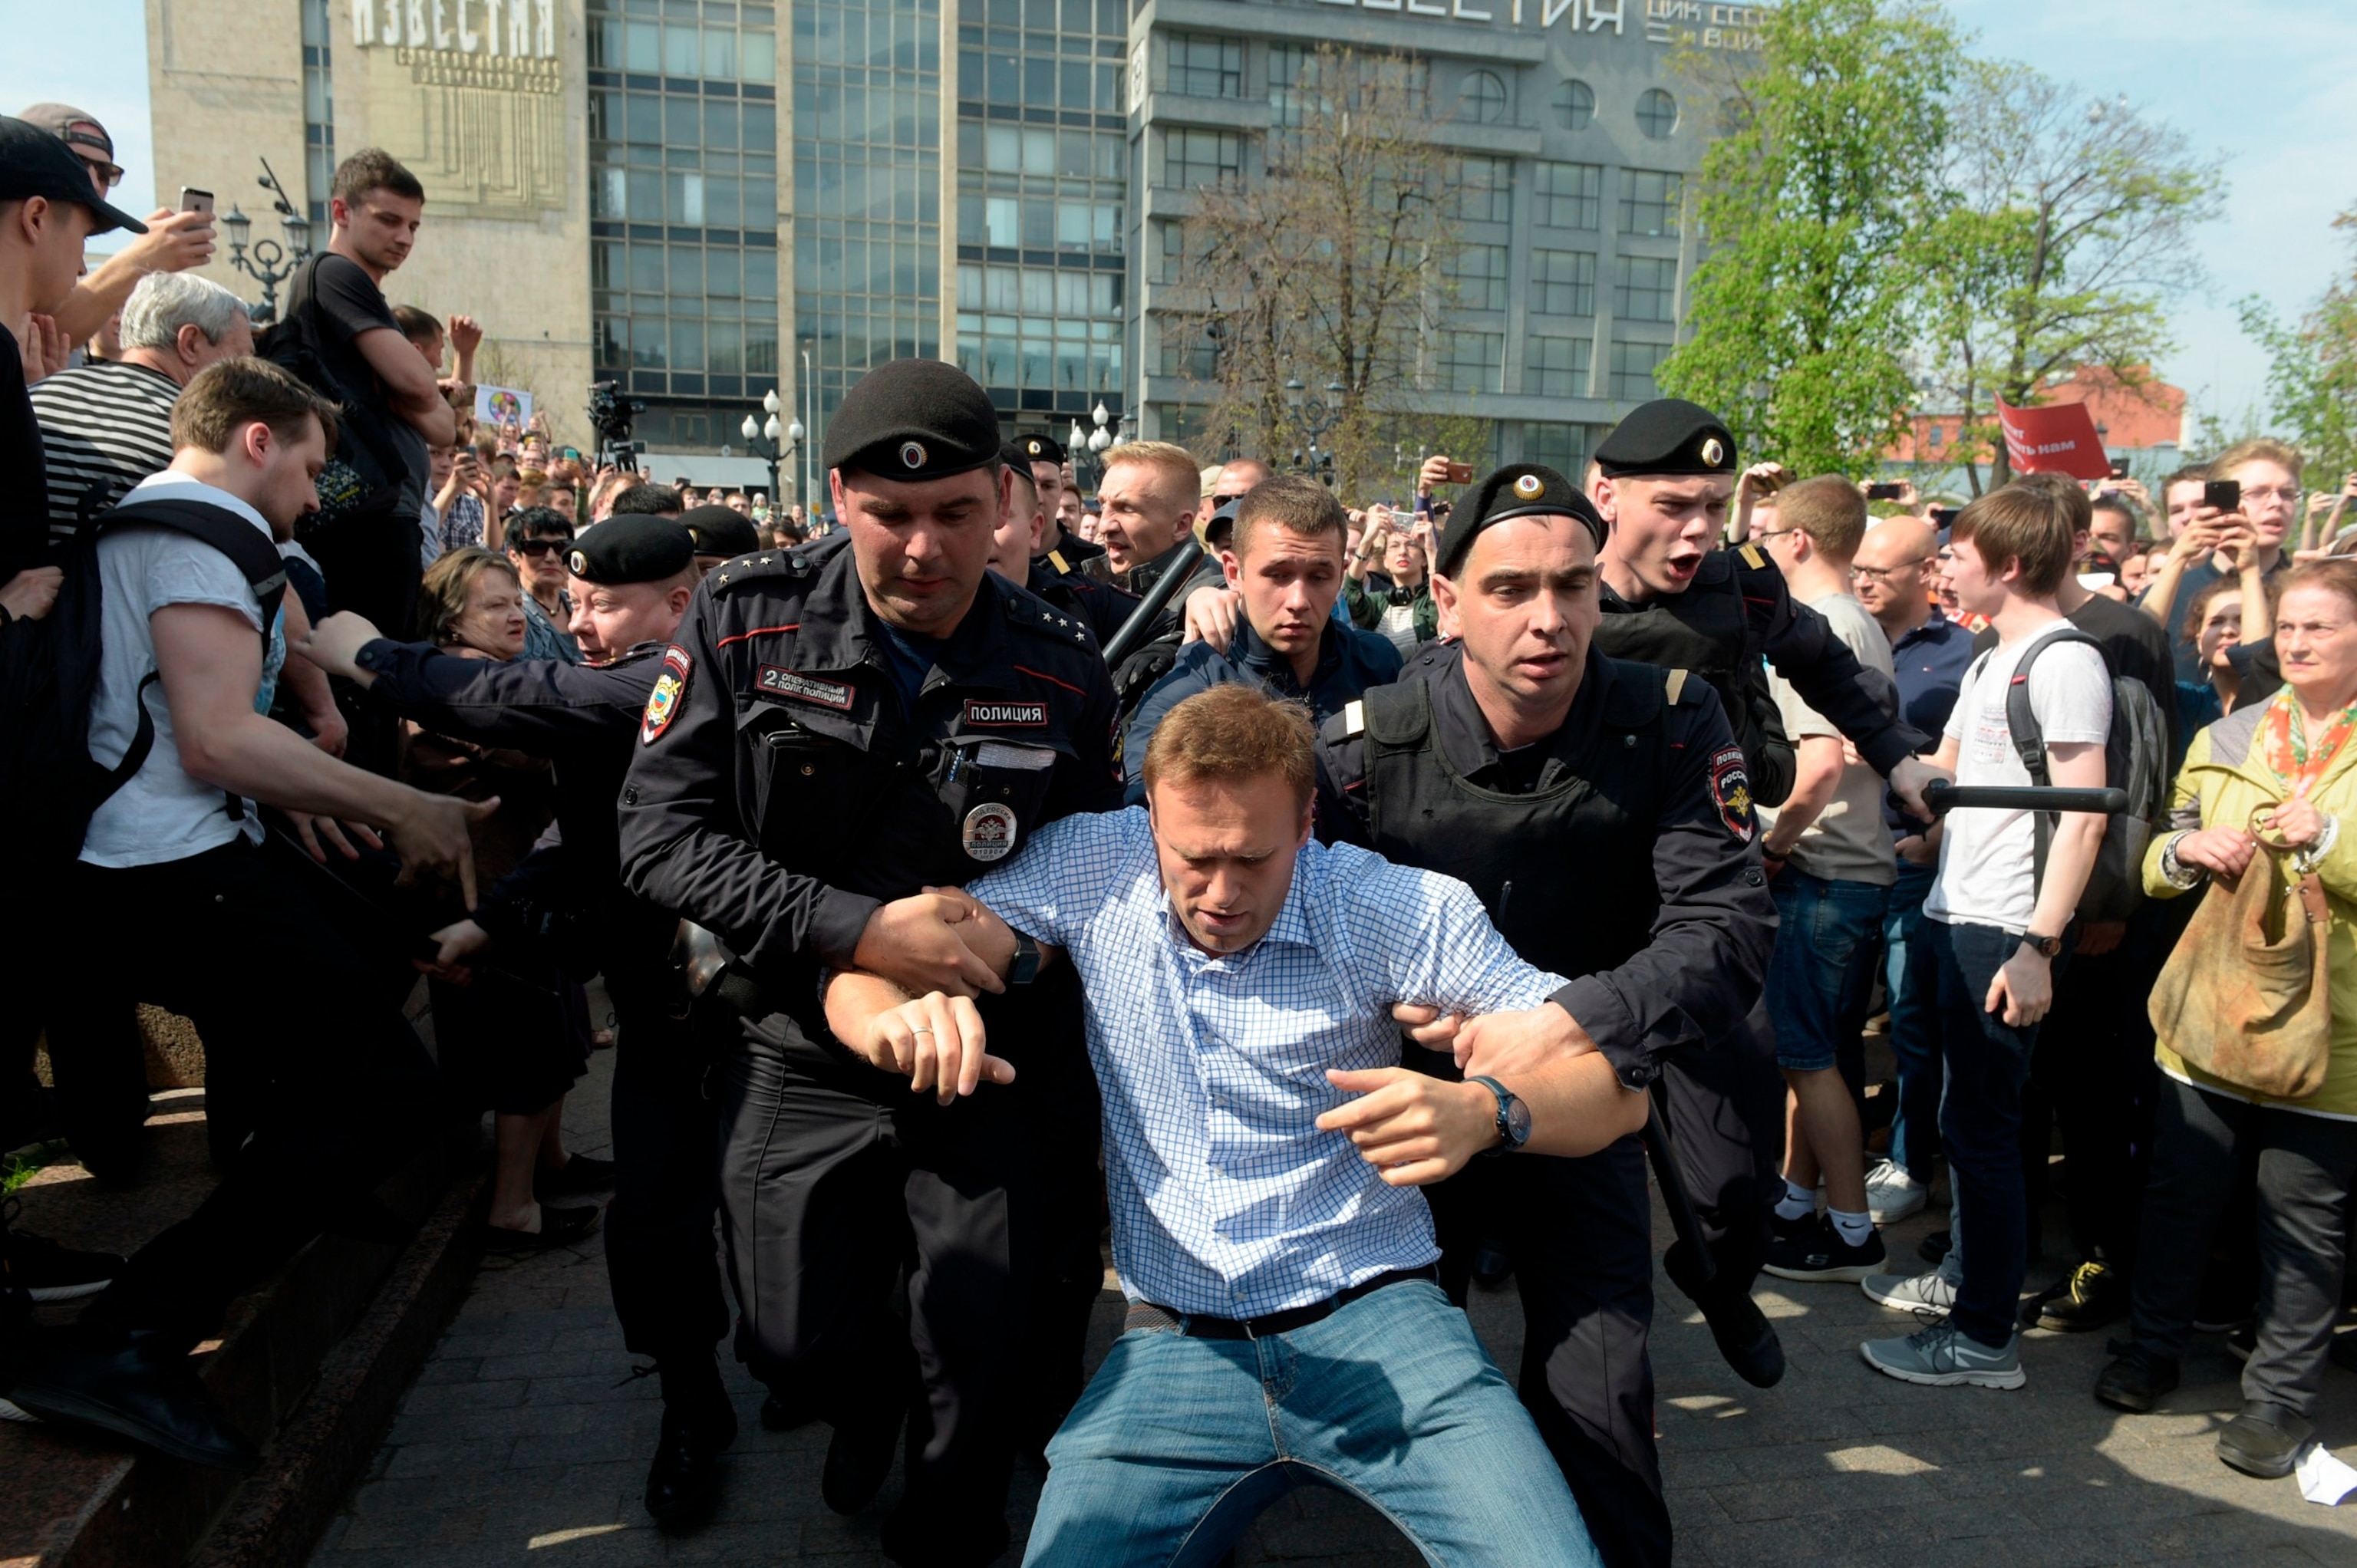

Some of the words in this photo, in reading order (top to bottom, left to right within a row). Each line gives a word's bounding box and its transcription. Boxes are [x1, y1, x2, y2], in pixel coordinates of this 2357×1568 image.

[763, 670, 778, 686] 2
[781, 674, 845, 695] ОПЕРАТИВНЫЙ
[777, 680, 802, 693] ПОЛК
[803, 687, 846, 704] ПОЛИЦИИ
[971, 707, 1042, 723] ПОЛИЦИЯ
[987, 806, 1012, 821] РОССИИ
